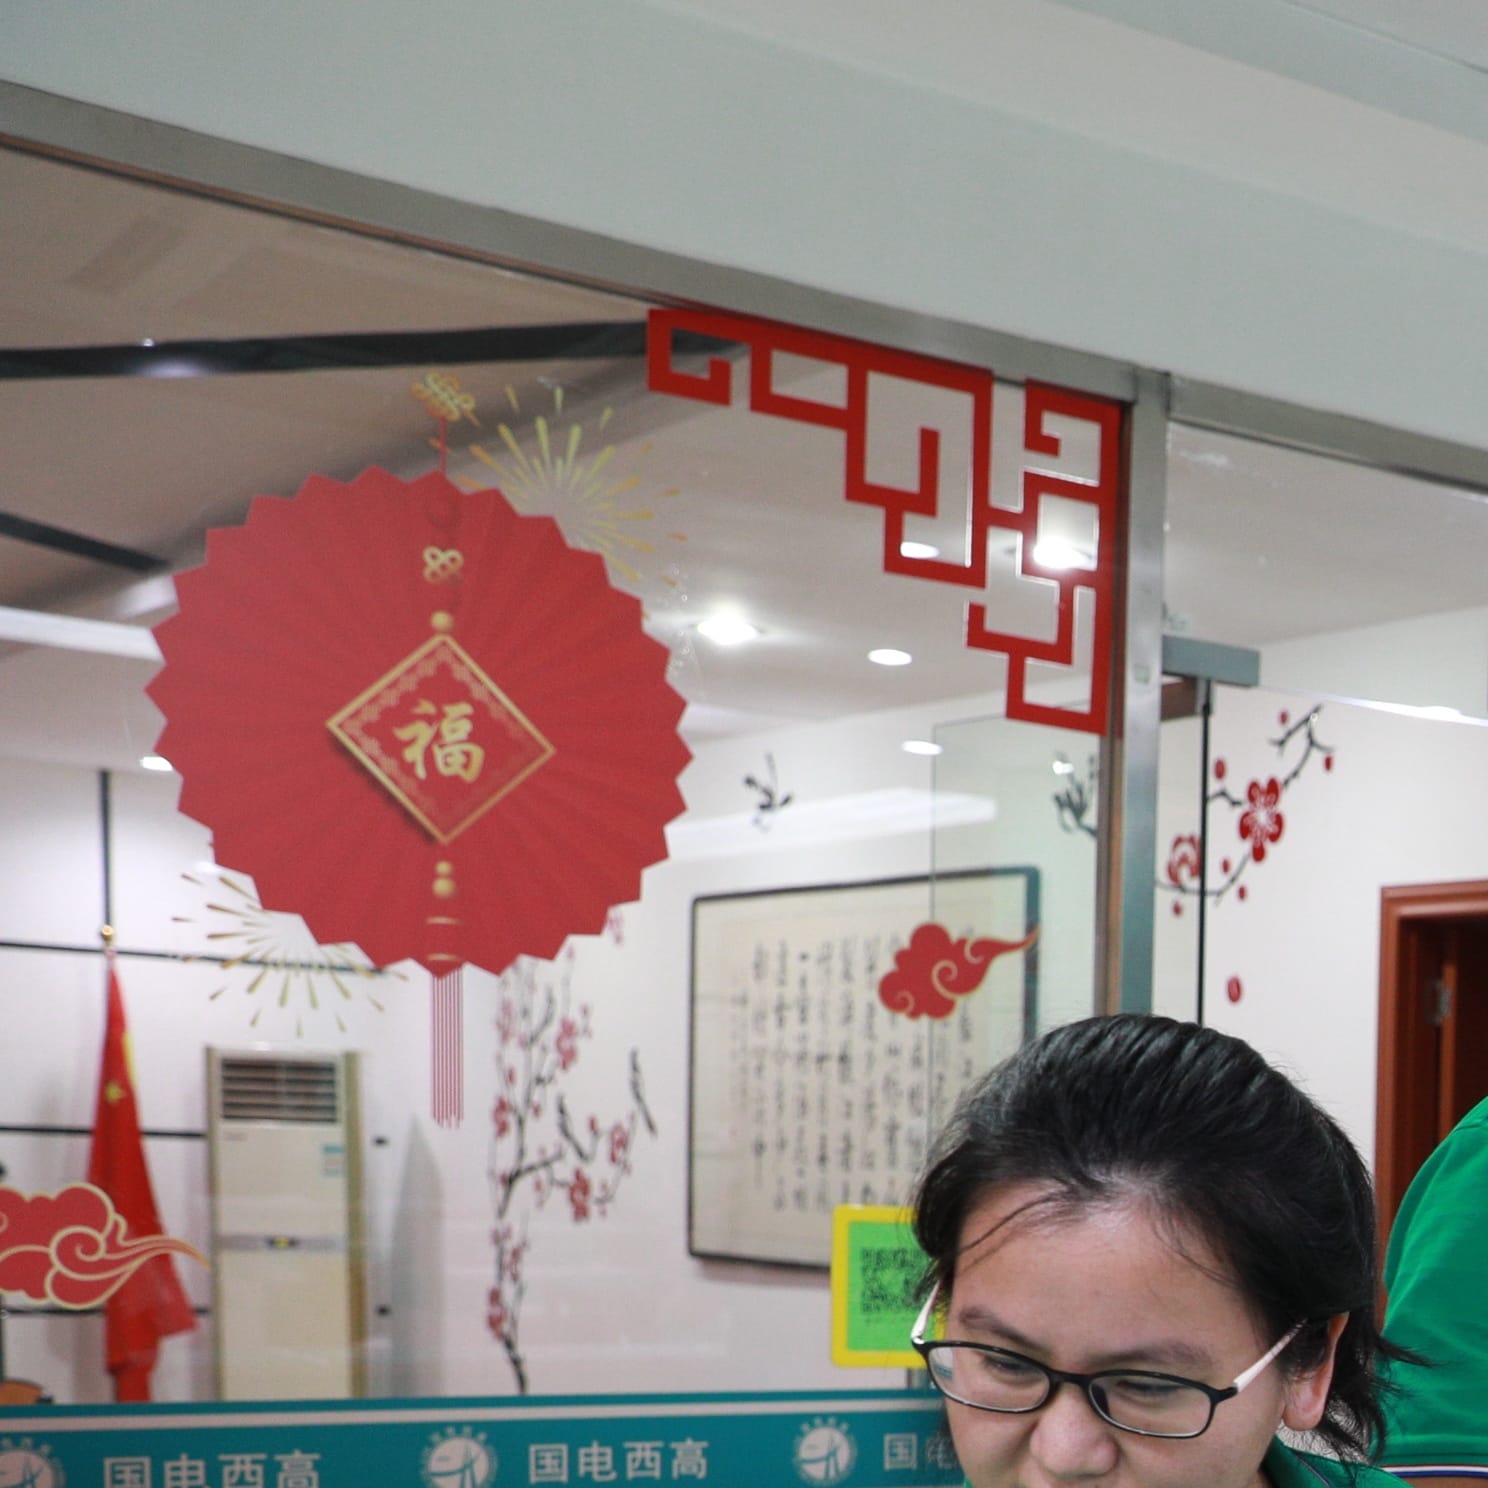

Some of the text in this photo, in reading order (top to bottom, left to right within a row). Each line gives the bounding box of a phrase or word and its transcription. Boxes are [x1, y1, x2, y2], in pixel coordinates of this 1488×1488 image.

[395, 700, 486, 783] 福
[528, 1438, 709, 1484] 国电西高
